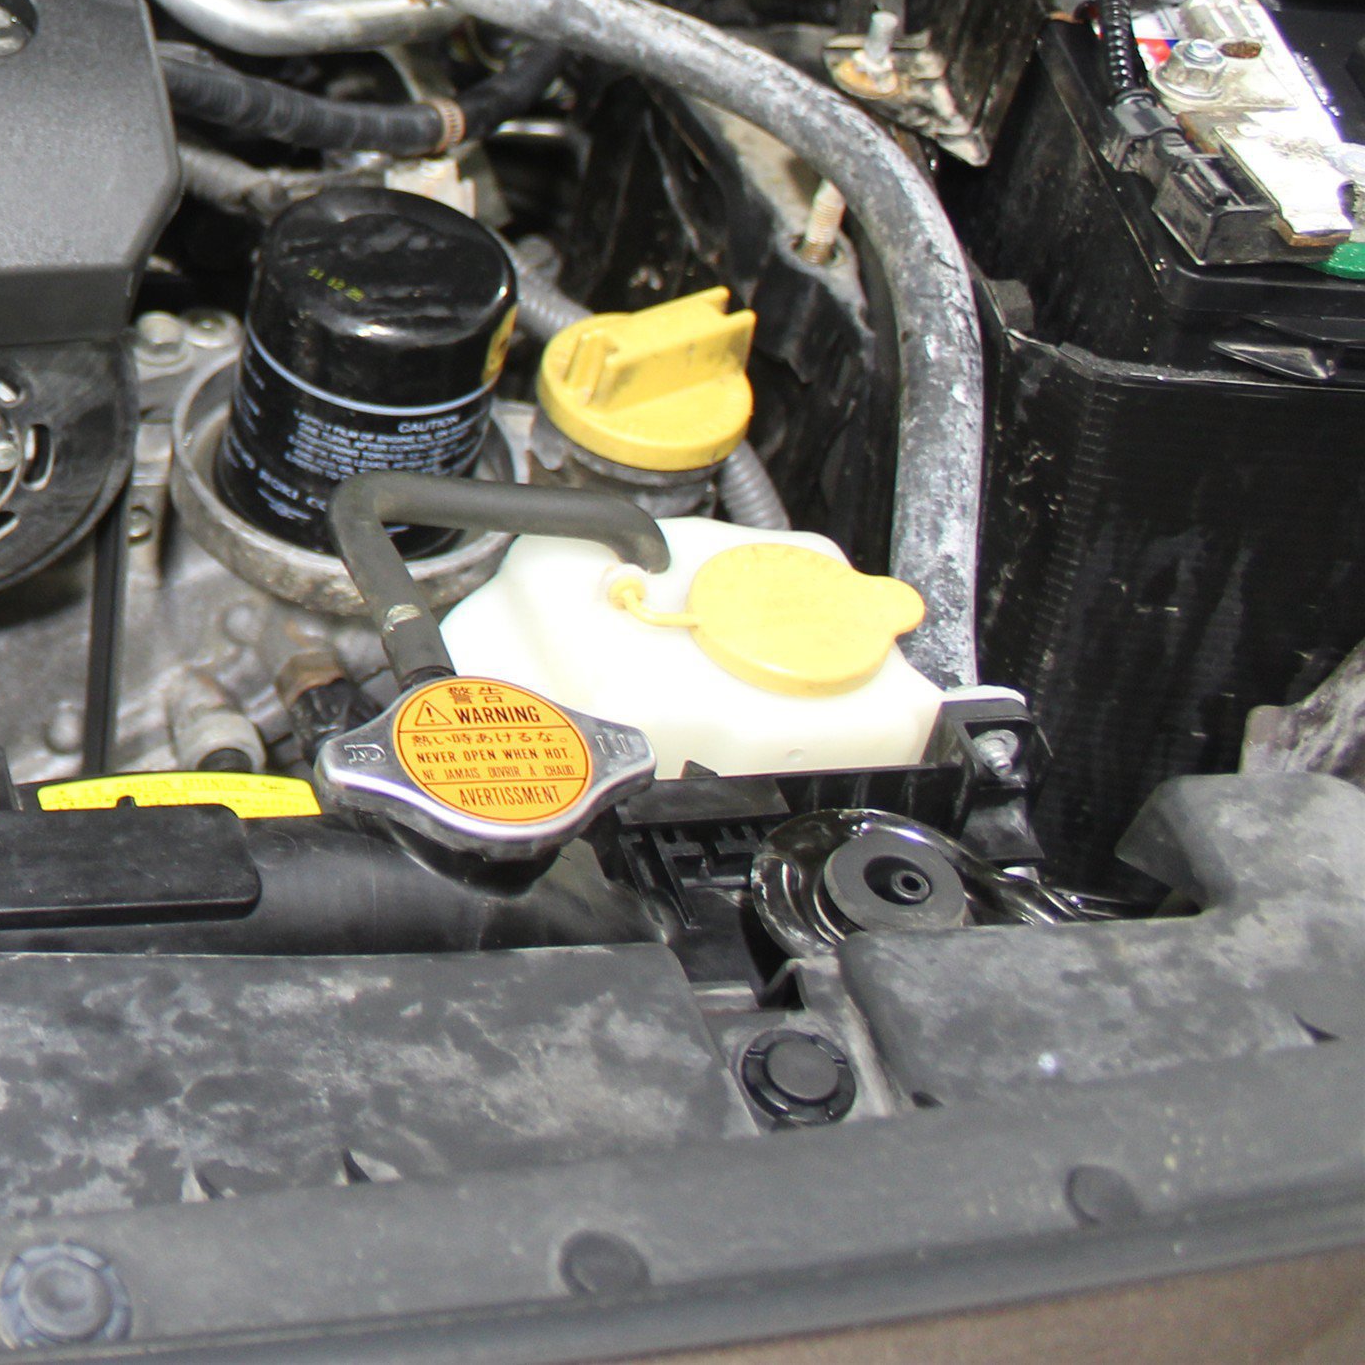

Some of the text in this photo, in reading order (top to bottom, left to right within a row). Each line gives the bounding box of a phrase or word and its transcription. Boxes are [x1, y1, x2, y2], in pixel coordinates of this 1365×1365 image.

[397, 414, 460, 433] CAUTION
[448, 686, 504, 704] 警告
[453, 706, 541, 725] WARNING
[416, 747, 574, 764] NEVER OPEN WHEN HOT.
[422, 769, 436, 781] NE
[444, 766, 481, 780] JAMAIS
[487, 765, 522, 778] OUVRIR
[527, 764, 537, 777] À
[459, 785, 563, 807] AVERTISSMENT
